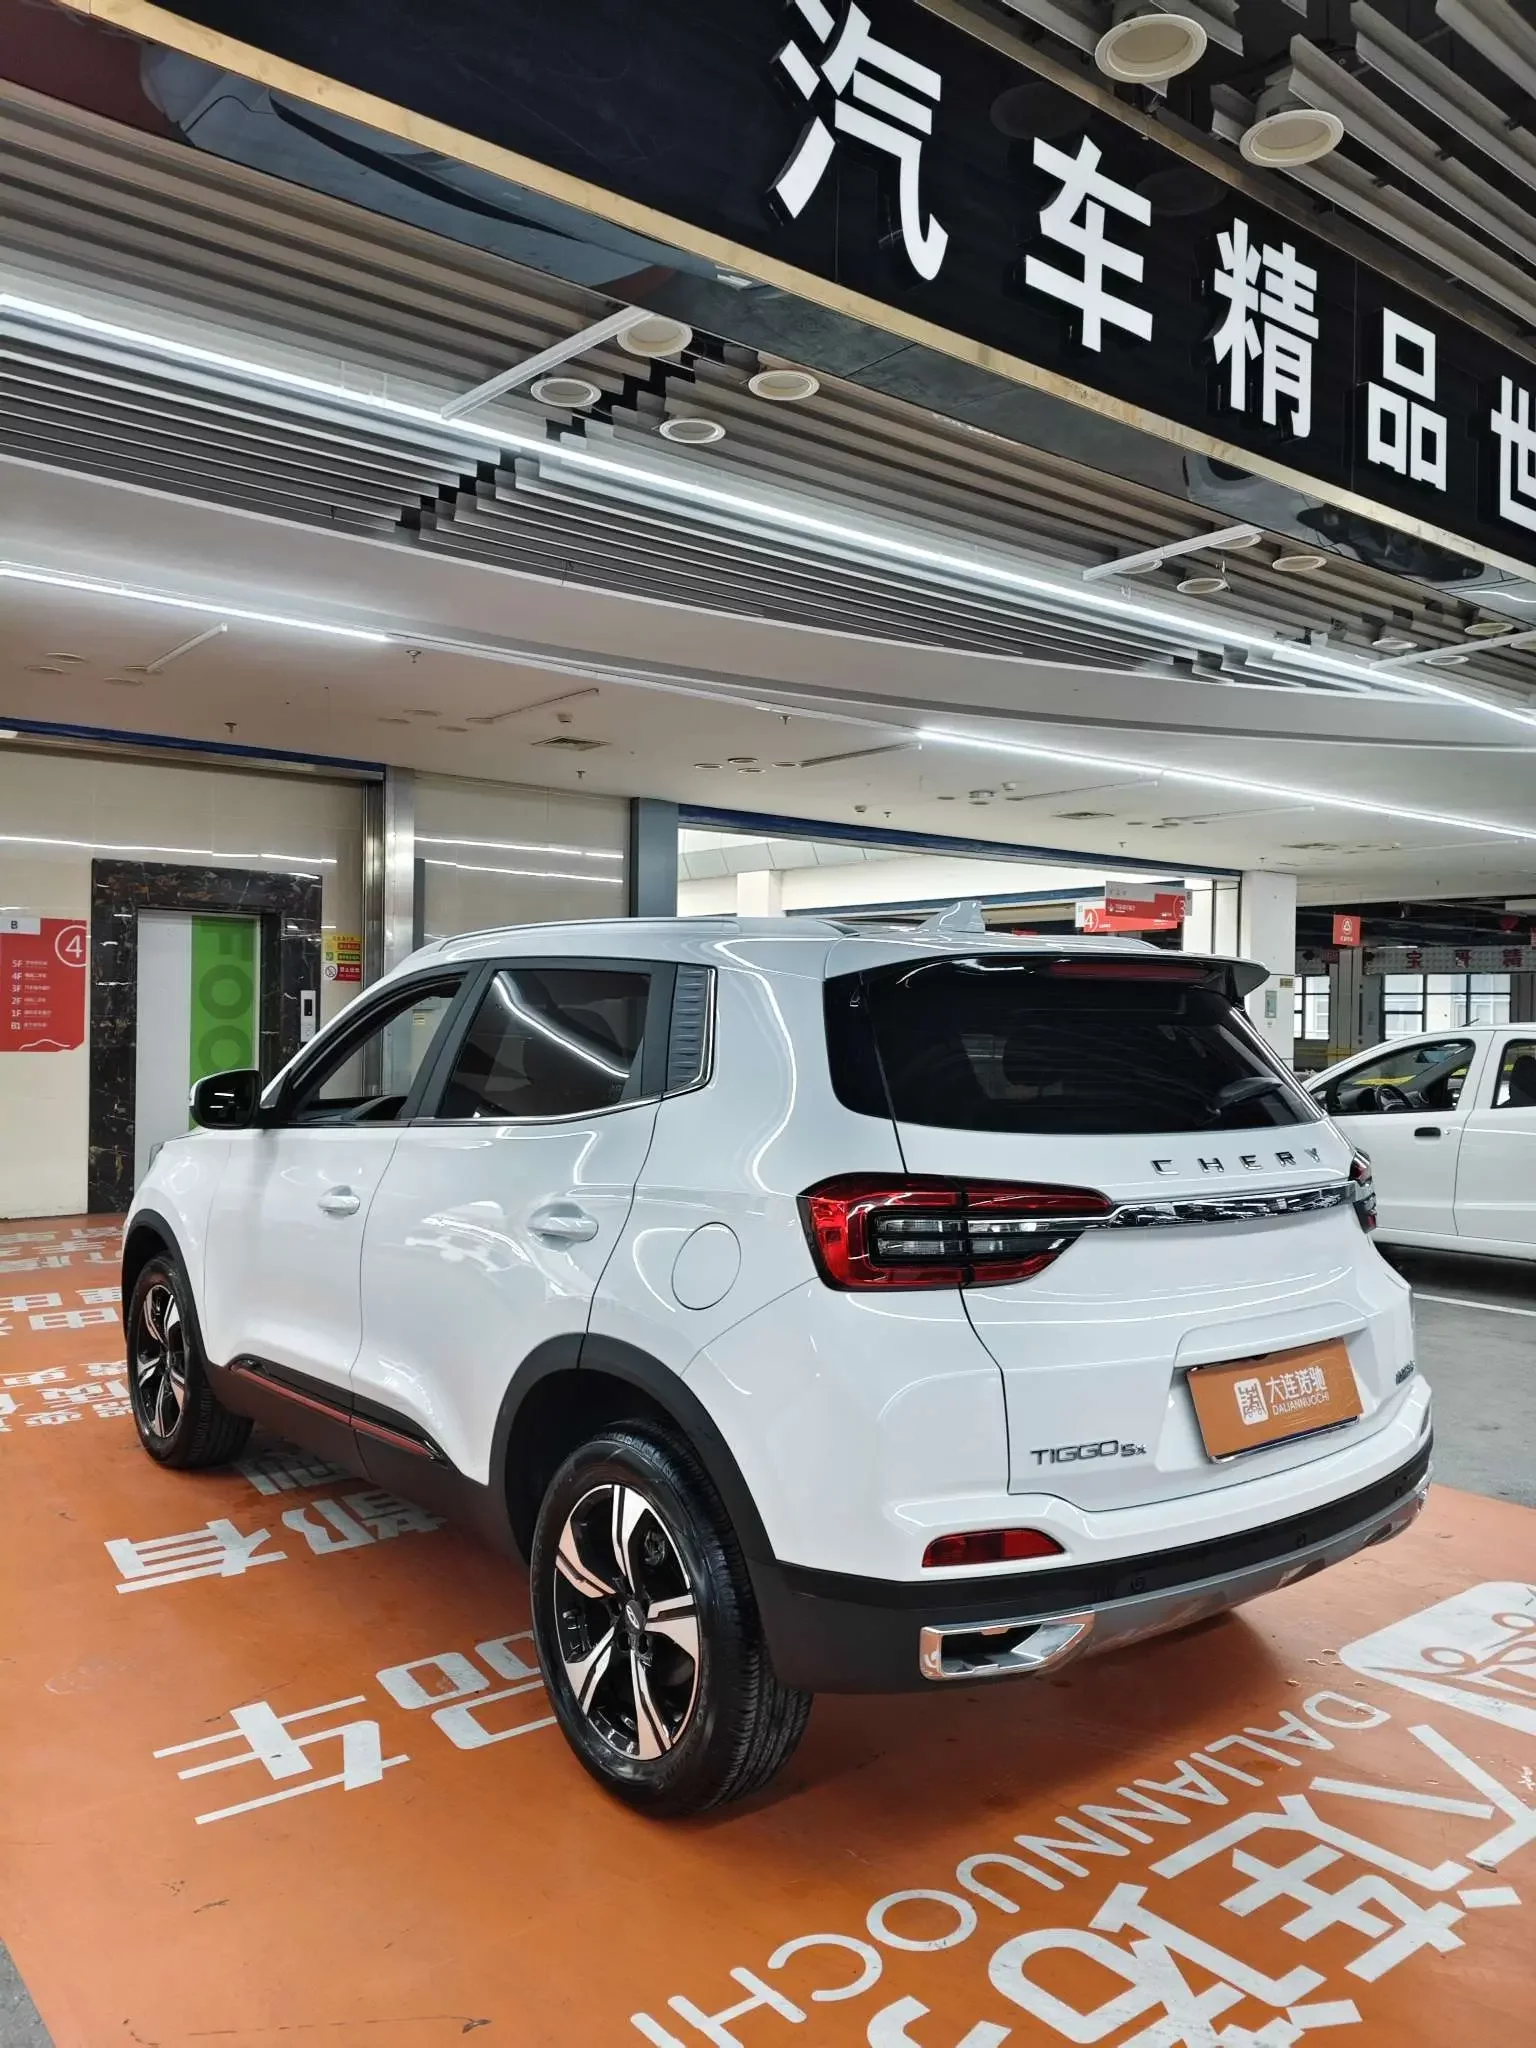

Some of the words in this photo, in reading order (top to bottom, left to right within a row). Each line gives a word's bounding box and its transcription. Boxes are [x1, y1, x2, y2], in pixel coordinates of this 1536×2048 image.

[10, 920, 18, 929] B
[1084, 912, 1094, 929] 4
[65, 934, 83, 959] 4
[12, 959, 22, 968] 5F
[11, 972, 22, 980] 4F
[11, 1009, 22, 1017] 1F
[1151, 1147, 1322, 1176] CHERY
[1265, 1365, 1328, 1403] 大连诺驰
